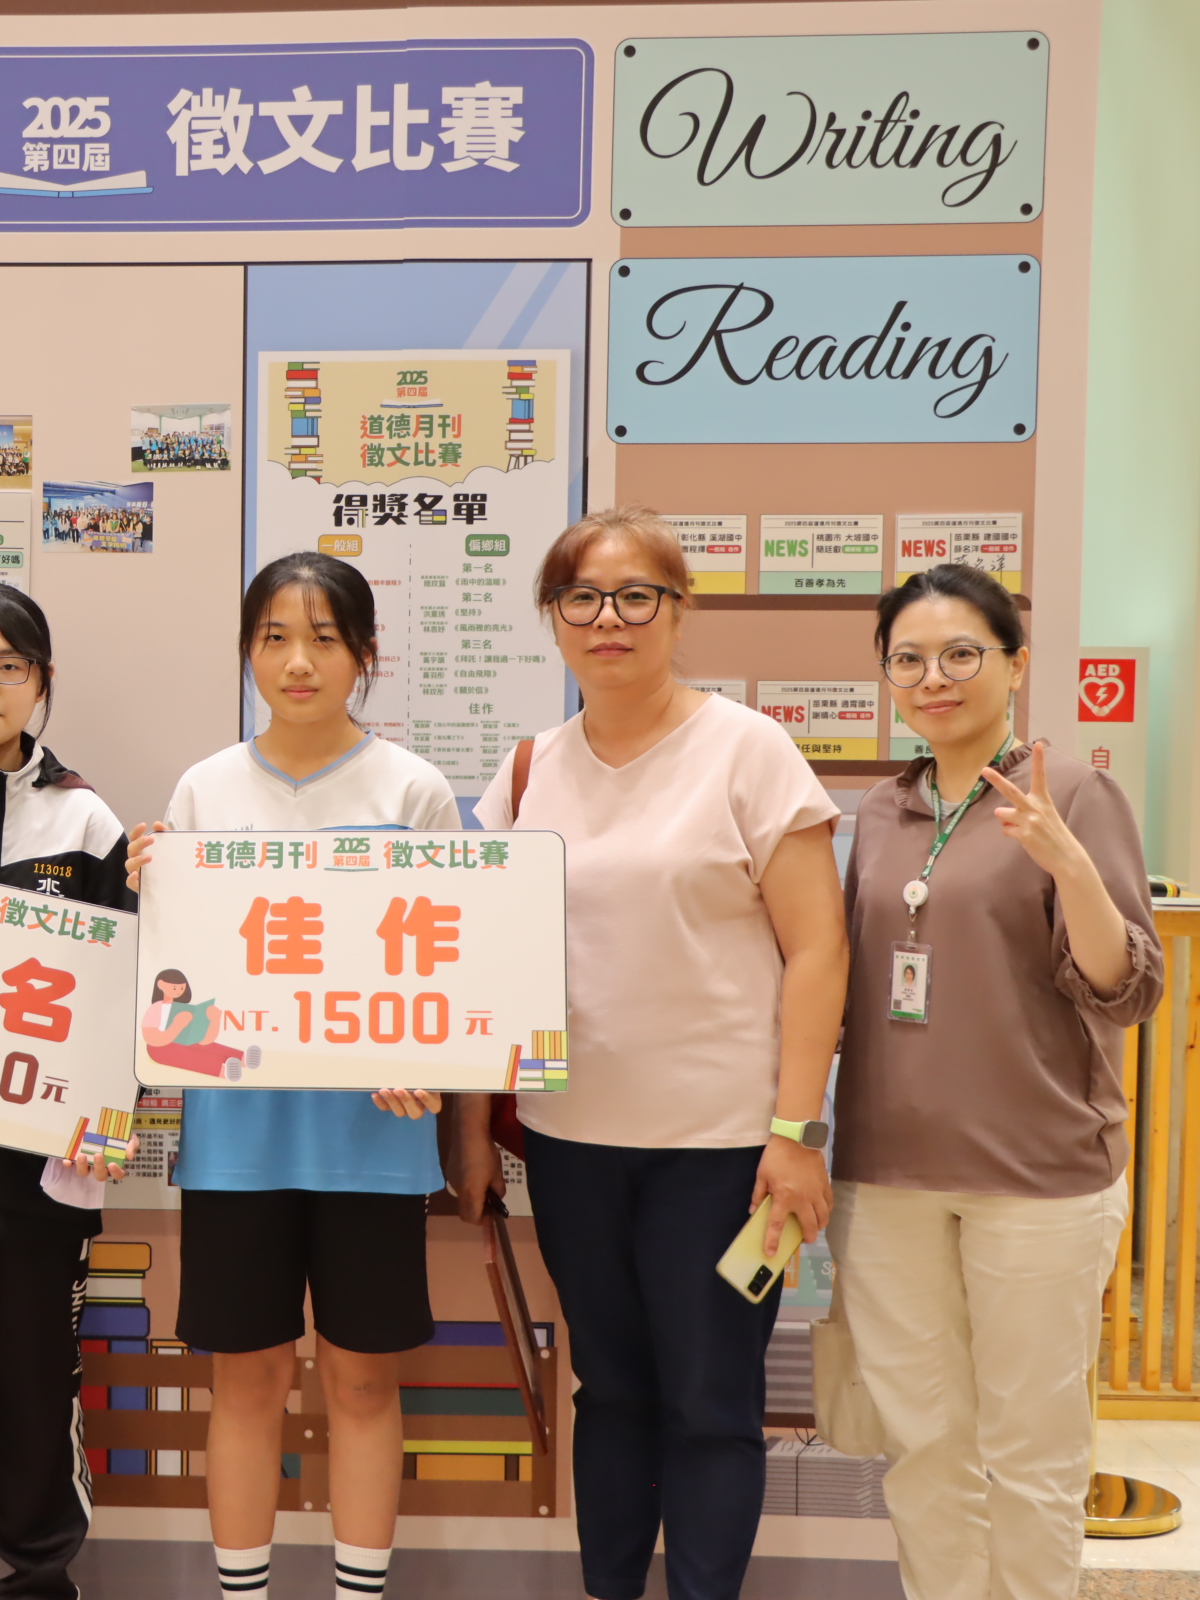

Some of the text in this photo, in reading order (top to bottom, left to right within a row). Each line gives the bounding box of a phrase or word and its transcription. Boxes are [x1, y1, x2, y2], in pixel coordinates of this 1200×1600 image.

[22, 96, 110, 139] 2025
[166, 81, 526, 176] 徵文比賽
[639, 67, 1018, 208] Writing
[21, 142, 111, 173] 第四屆
[635, 281, 1009, 419] Reading
[397, 371, 428, 386] 2025
[397, 387, 428, 398] 第四屆
[360, 414, 462, 439] 道德月刊
[360, 443, 462, 468] 徵文比賽
[332, 493, 488, 528] 得獎名單
[322, 539, 358, 552] 一般組
[469, 539, 507, 552] 偏鄉組
[764, 539, 809, 557] NEWS
[901, 539, 946, 557] NEWS
[462, 563, 493, 573] 第一名
[794, 578, 846, 588] 百善孝為先
[461, 592, 493, 603] 第二名
[461, 639, 492, 650] 第三名
[1085, 664, 1120, 676] AED
[468, 703, 494, 714] 佳作
[761, 705, 805, 723] NEWS
[1091, 746, 1110, 770] 自
[195, 840, 318, 869] 道德月刊
[332, 837, 371, 854] 2025
[383, 840, 510, 869] 徵文比賽
[33, 863, 73, 877] 113018
[332, 855, 370, 868] 第四屆
[0, 895, 118, 947] 徵文比賽
[239, 896, 461, 977] 佳作
[293, 990, 449, 1044] 1500
